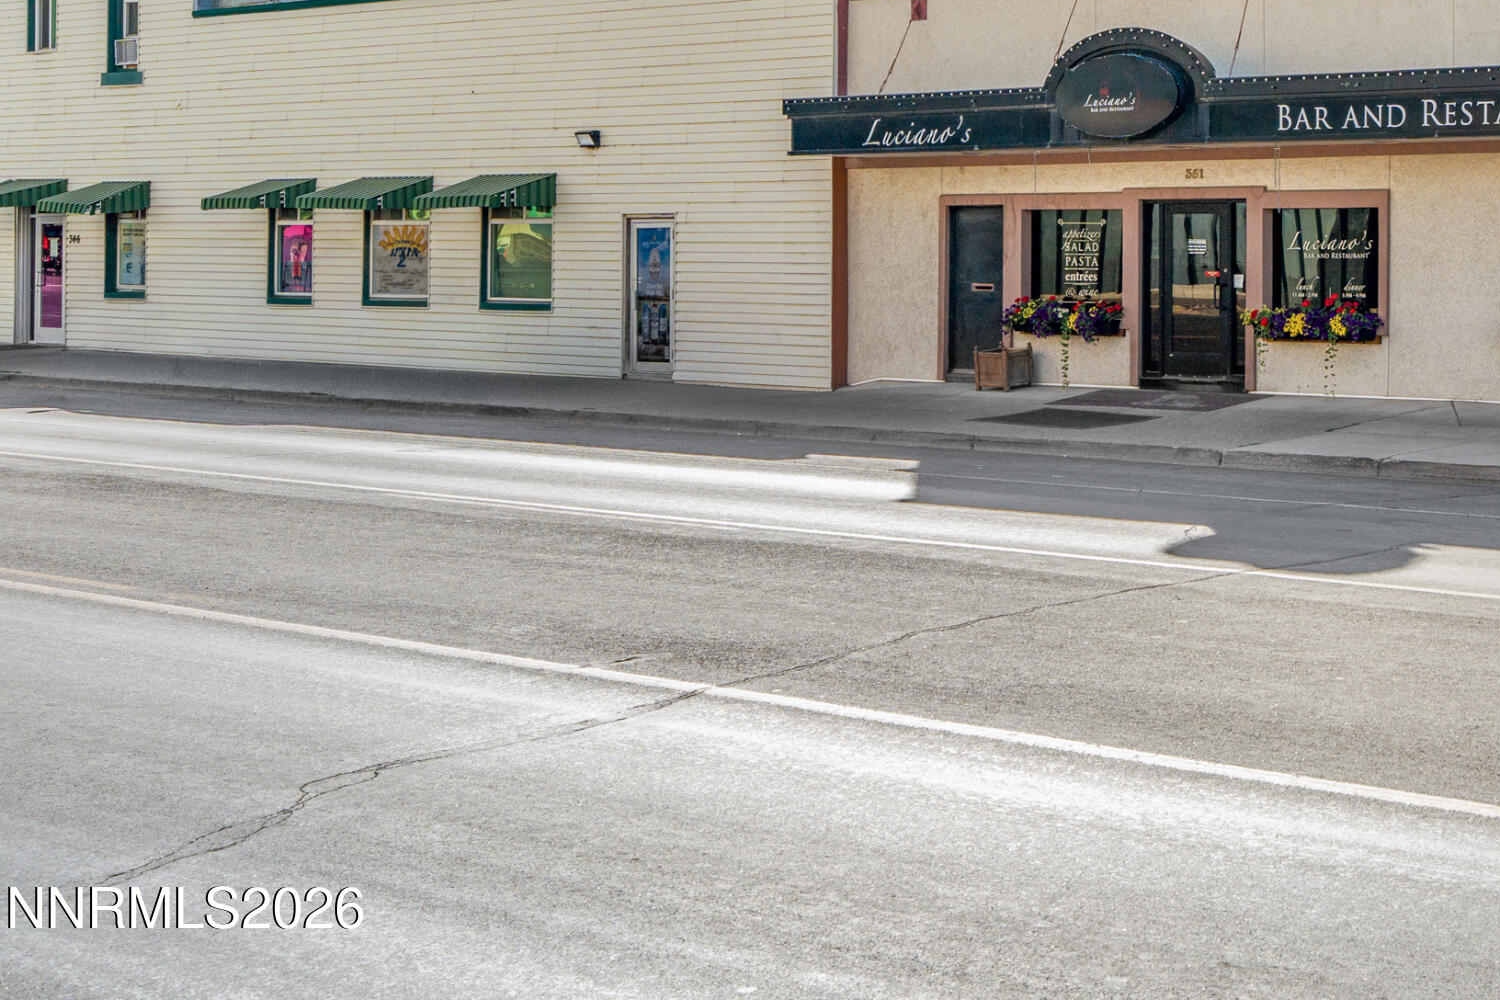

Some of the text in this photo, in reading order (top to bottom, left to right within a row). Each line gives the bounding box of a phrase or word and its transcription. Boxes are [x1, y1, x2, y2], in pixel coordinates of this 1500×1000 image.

[1083, 91, 1136, 107] Luciano's
[1277, 104, 1333, 131] BAR
[1341, 104, 1407, 129] AND
[862, 116, 972, 147] Luciano's
[1064, 242, 1099, 252] SALAD
[1287, 230, 1373, 251] Luciano's
[1065, 256, 1099, 267] PASTA
[1065, 271, 1098, 282] entrées
